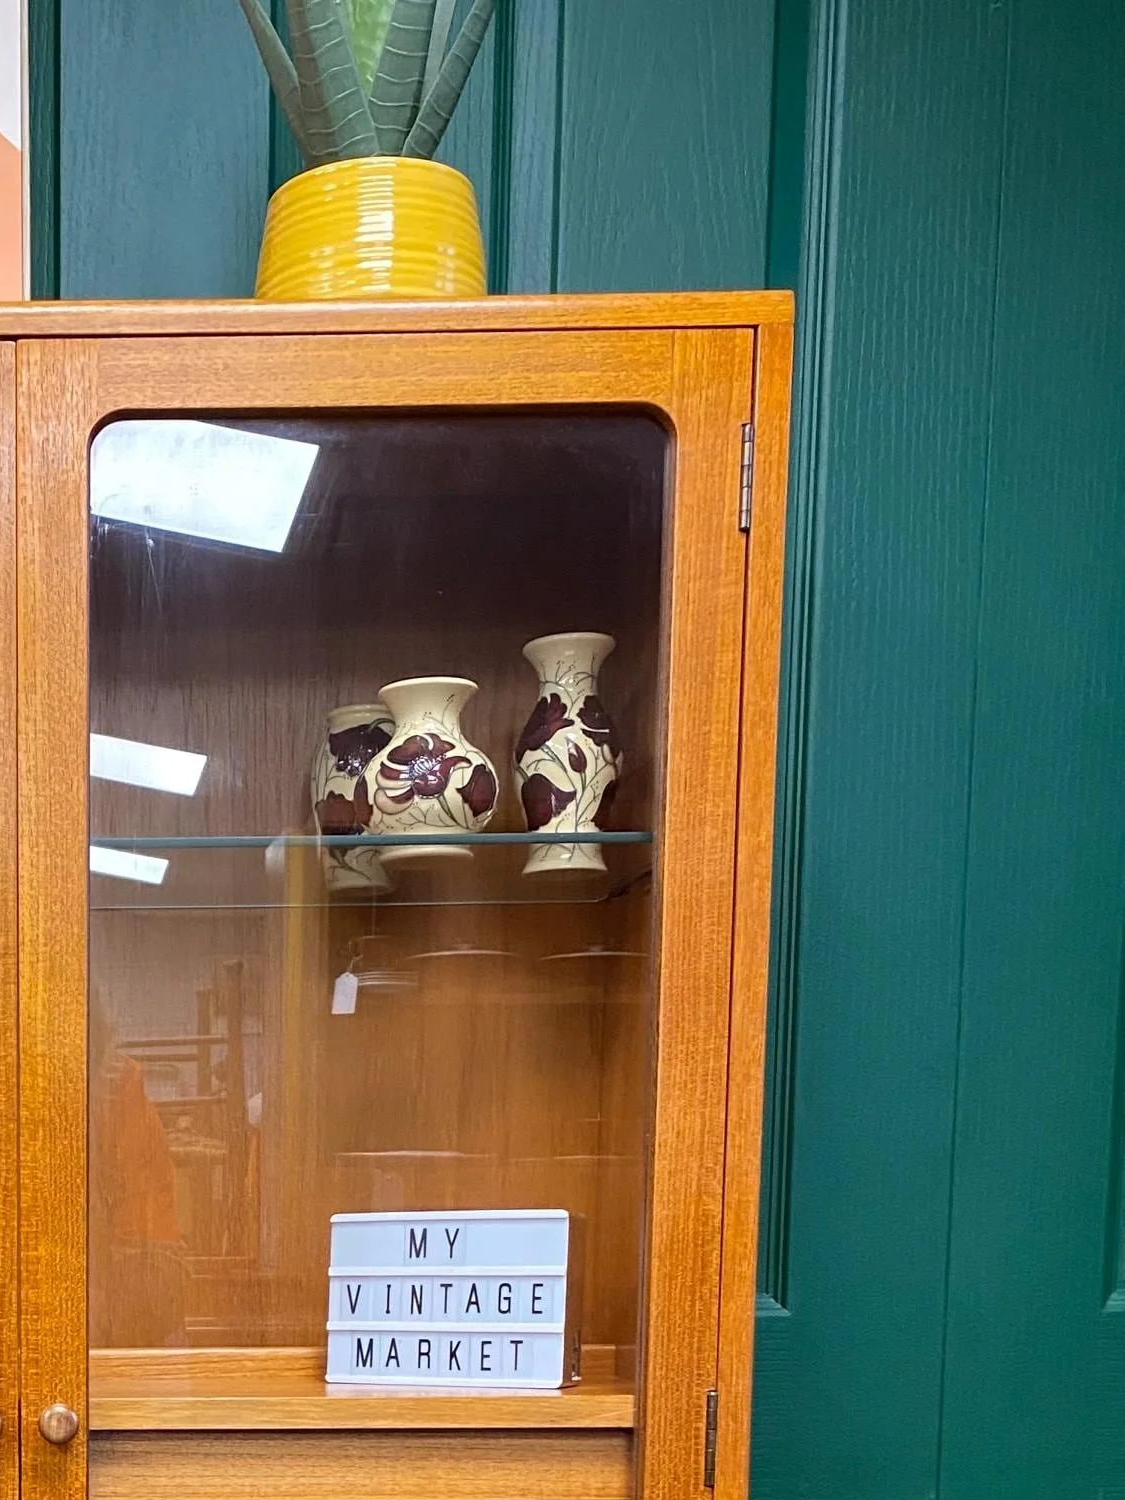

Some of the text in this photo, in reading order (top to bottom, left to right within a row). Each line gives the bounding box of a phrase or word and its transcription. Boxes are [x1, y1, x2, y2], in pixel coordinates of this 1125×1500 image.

[409, 1228, 459, 1259] MY
[347, 1283, 544, 1314] VINTAGE
[356, 1338, 523, 1371] MARKET
